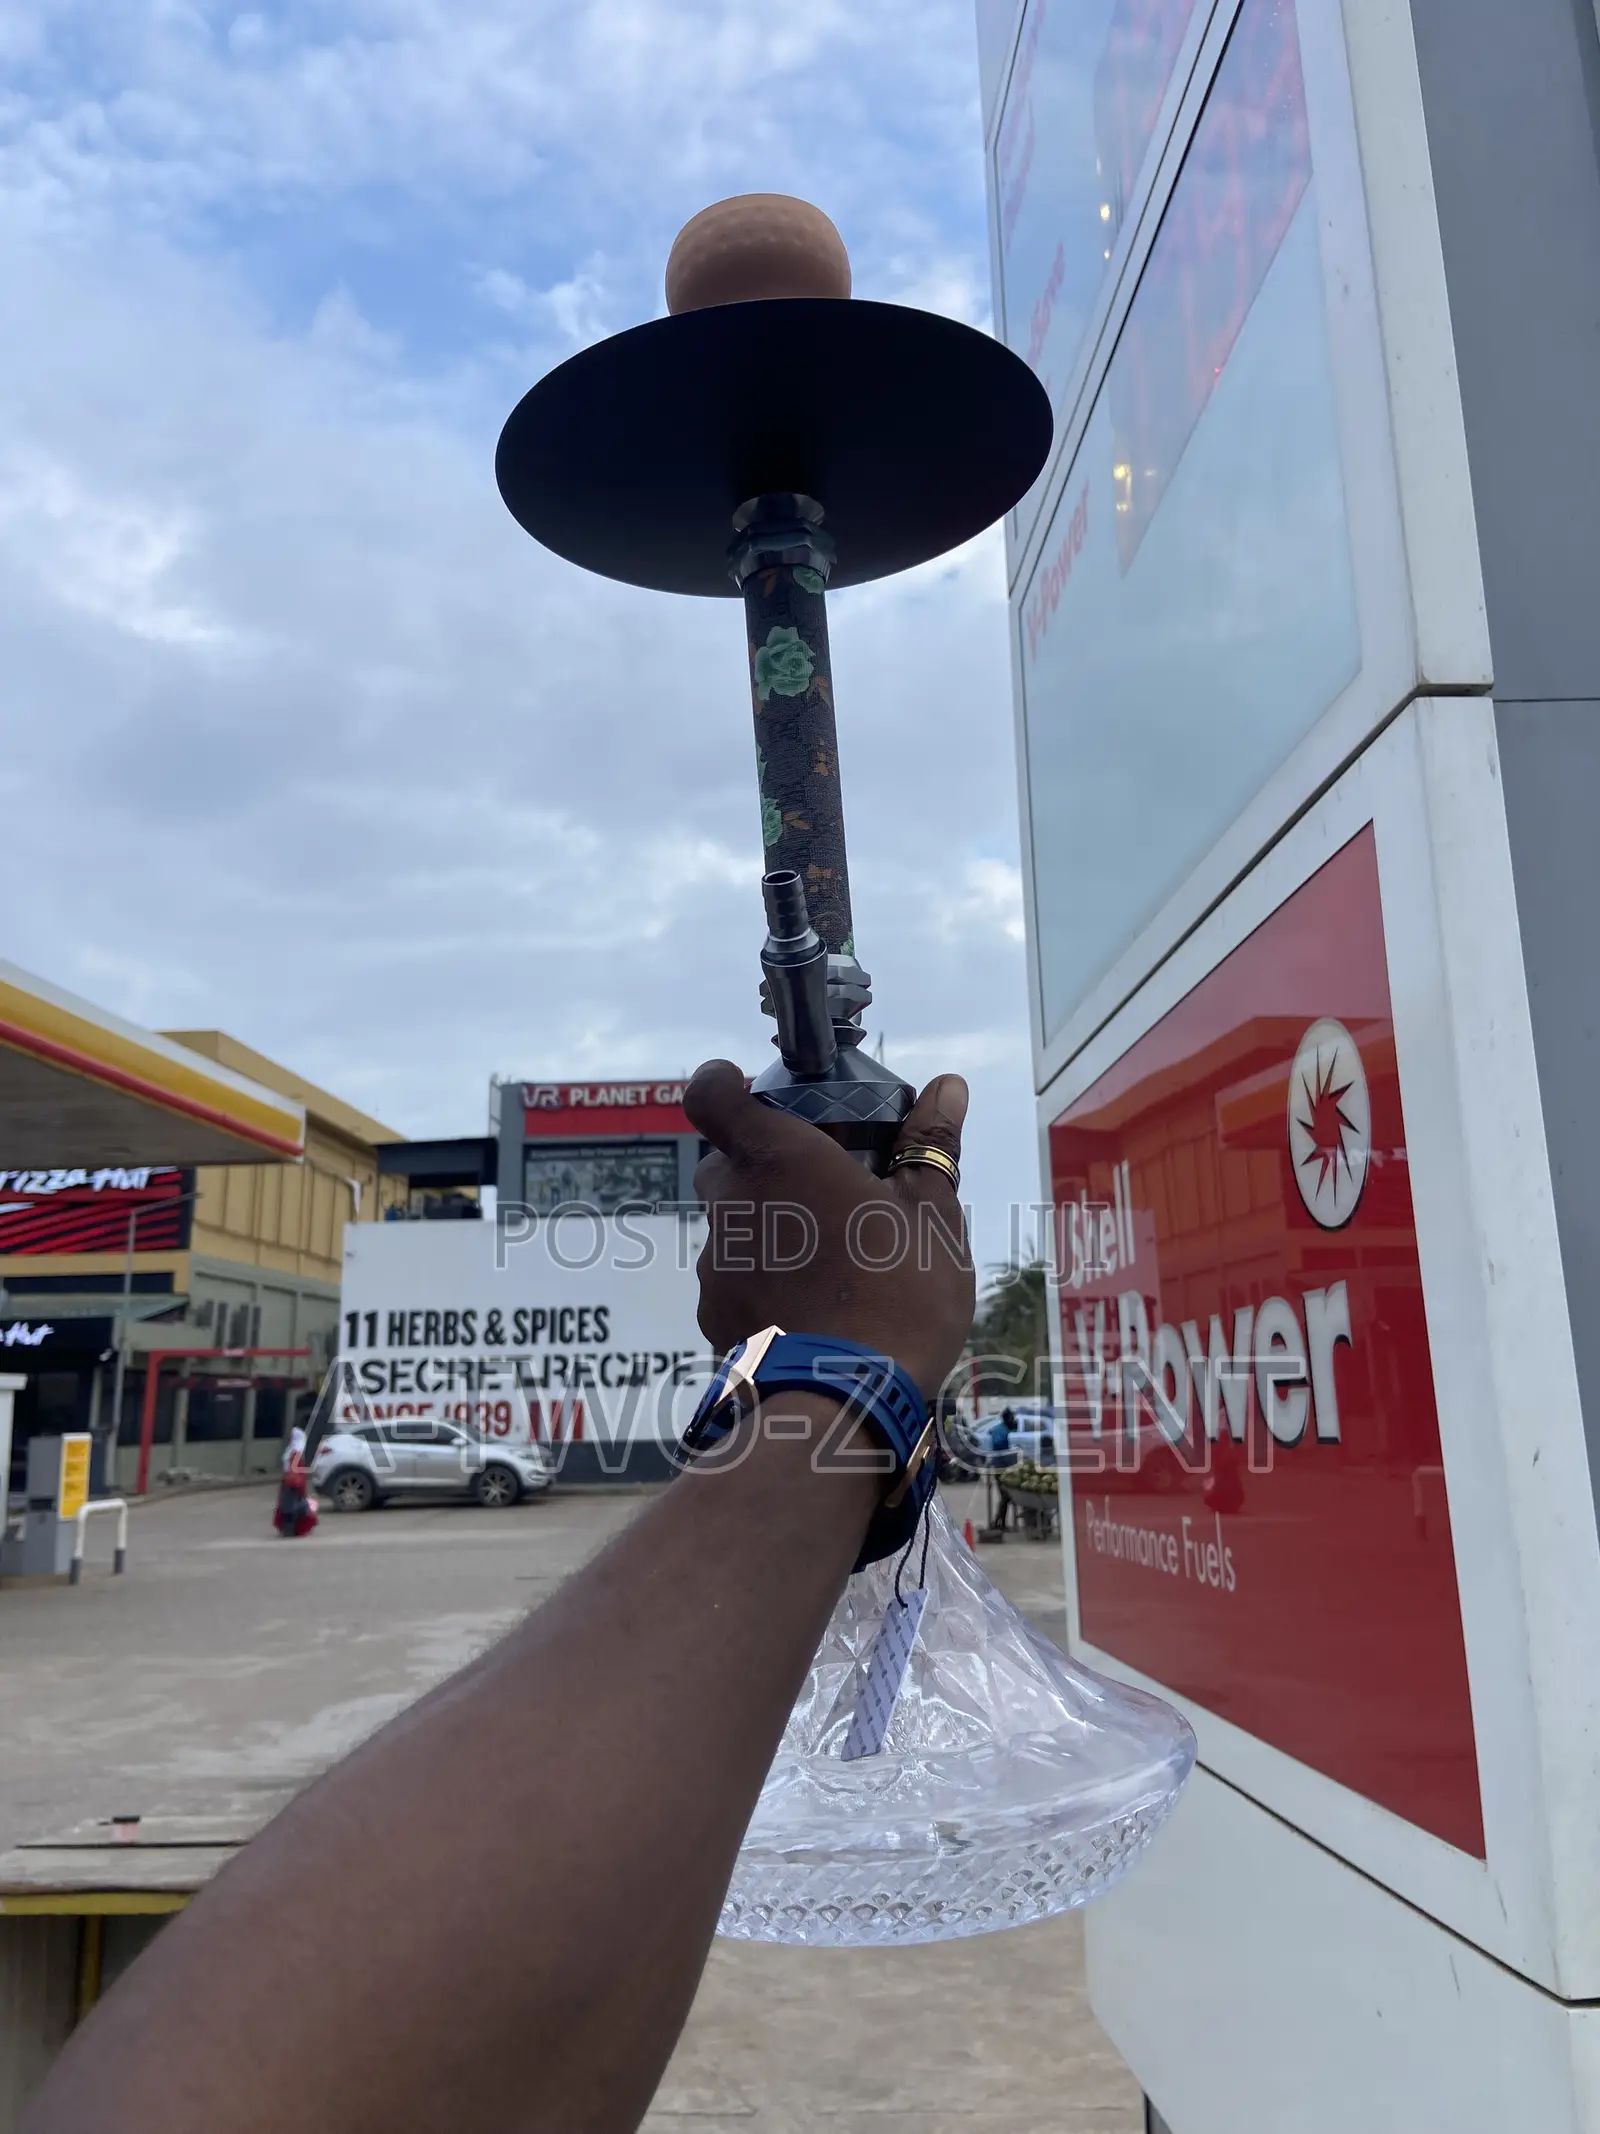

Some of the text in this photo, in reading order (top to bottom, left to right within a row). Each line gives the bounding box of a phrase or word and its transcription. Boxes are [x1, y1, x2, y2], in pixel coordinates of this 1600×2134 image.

[569, 1085, 650, 1107] PLANET
[345, 1304, 610, 1349] 11 HERBS & SPICES
[1074, 1279, 1352, 1448] V-Power
[1085, 1495, 1236, 1593] Performance Fuels
